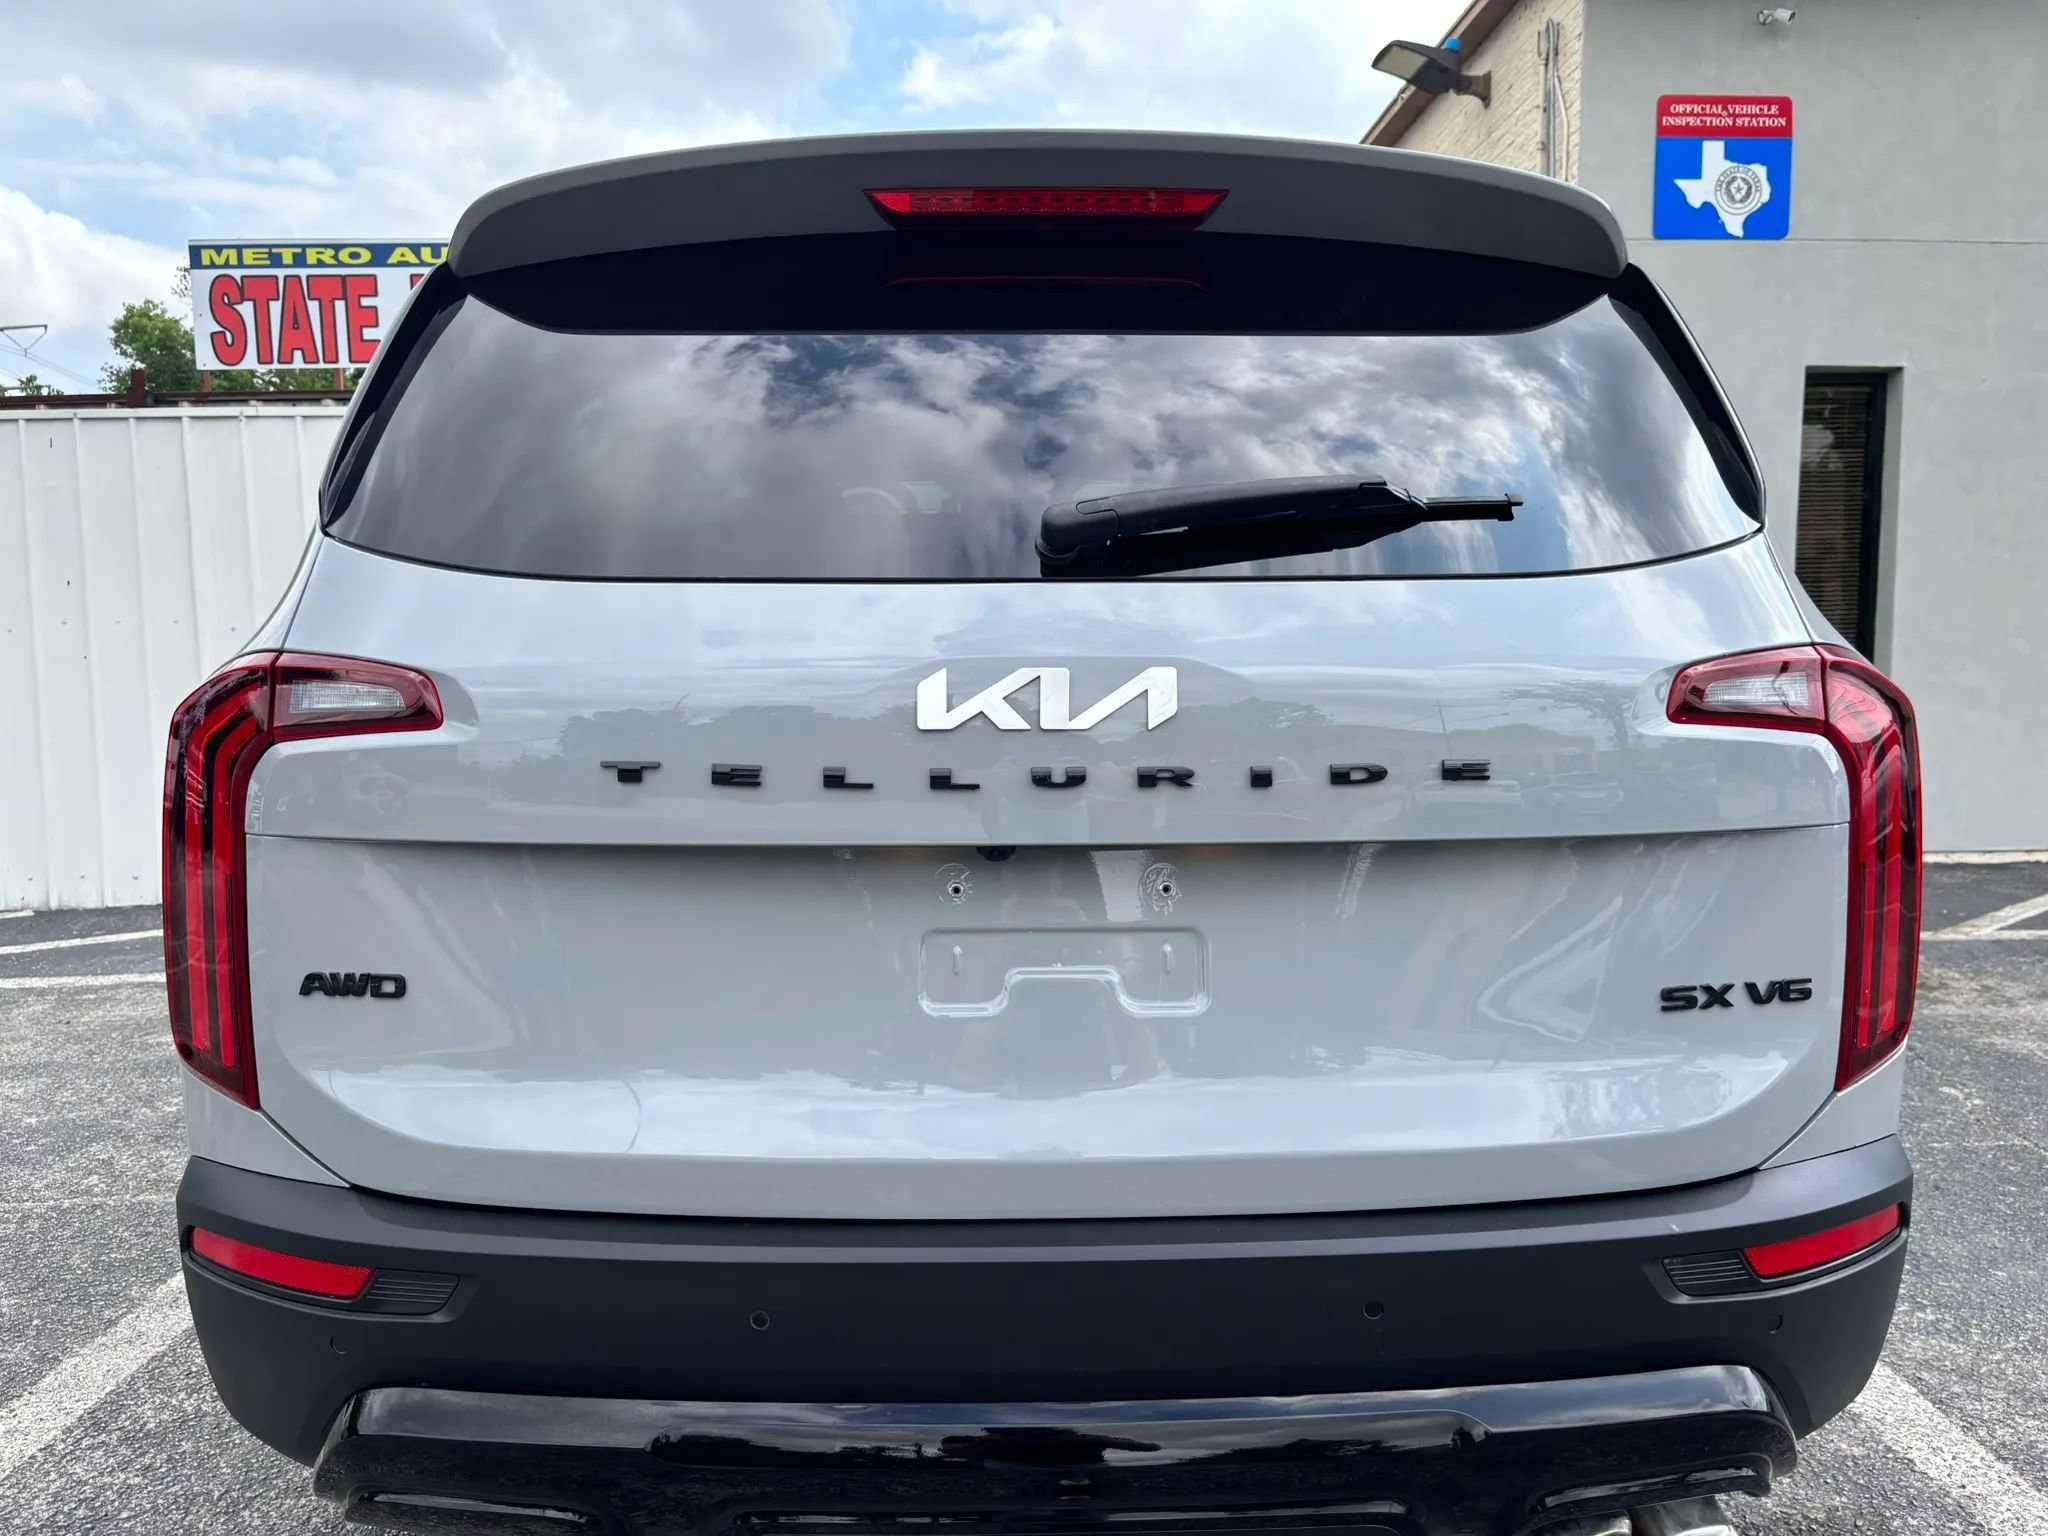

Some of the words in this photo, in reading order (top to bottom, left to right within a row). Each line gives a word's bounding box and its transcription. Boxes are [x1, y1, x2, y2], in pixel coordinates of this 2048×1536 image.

[1662, 116, 1733, 126] INSPECTION
[1735, 117, 1787, 127] STATION
[1670, 103, 1724, 114] OFFICIAL
[1727, 104, 1779, 115] VEHICLE
[200, 246, 372, 266] METRO
[386, 246, 449, 265] AU
[209, 273, 381, 366] STATE
[917, 666, 1178, 730] KIA
[600, 759, 1491, 790] TELLURIDE
[299, 972, 407, 999] AWD
[1660, 983, 1735, 1012] SX
[1744, 978, 1812, 1005] V6
